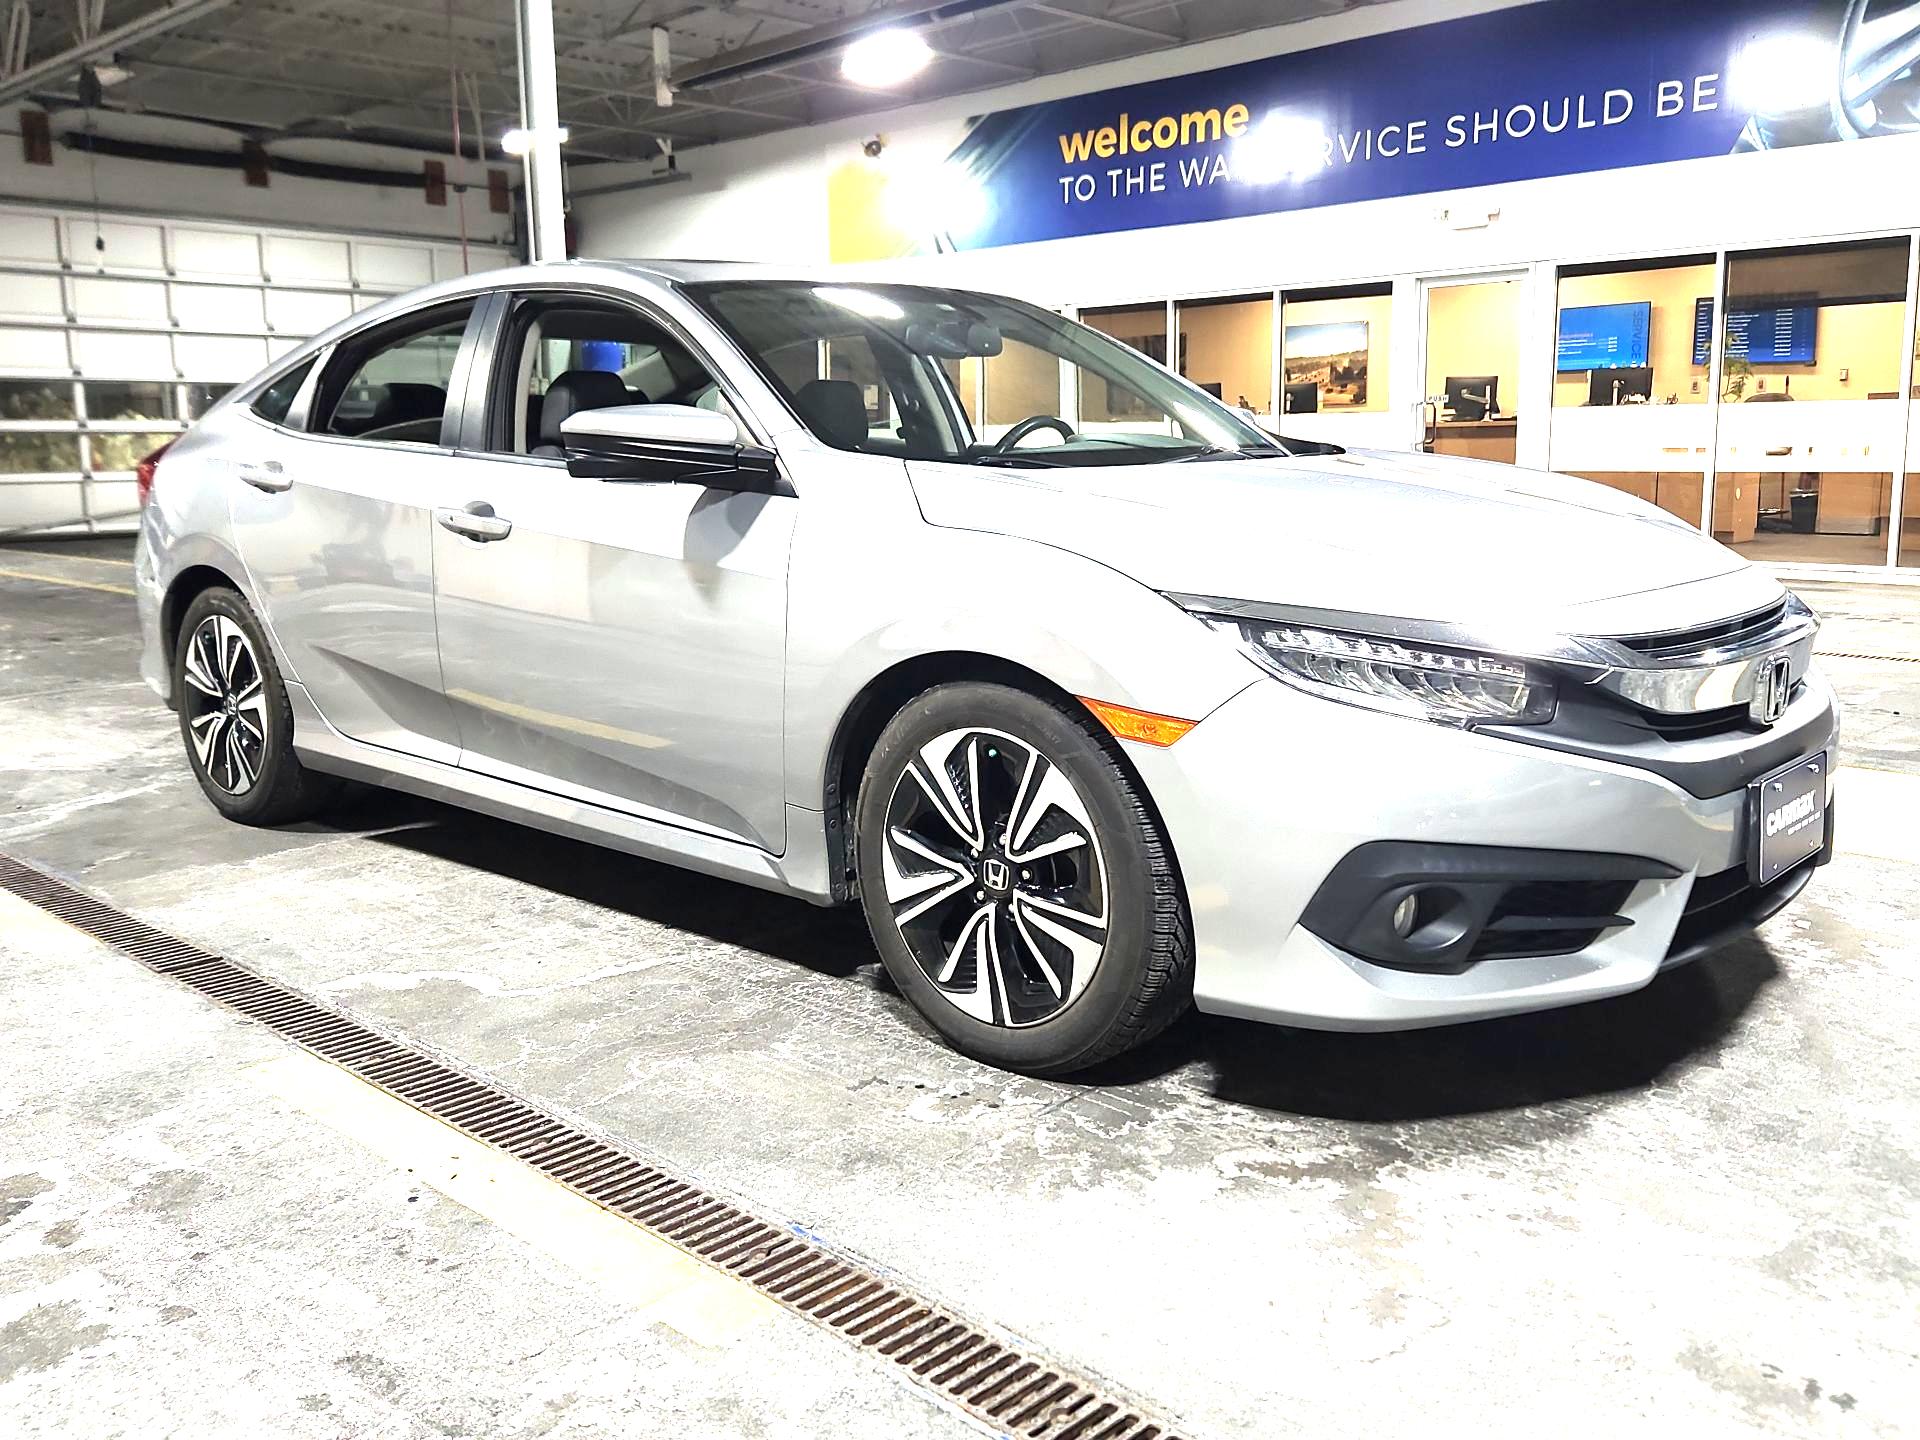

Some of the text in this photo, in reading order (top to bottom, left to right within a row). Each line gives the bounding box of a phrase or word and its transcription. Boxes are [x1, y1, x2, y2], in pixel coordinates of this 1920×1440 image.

[1059, 102, 1250, 164] welcome
[1059, 73, 1719, 204] TO THE WA RVICE SHOULD BE
